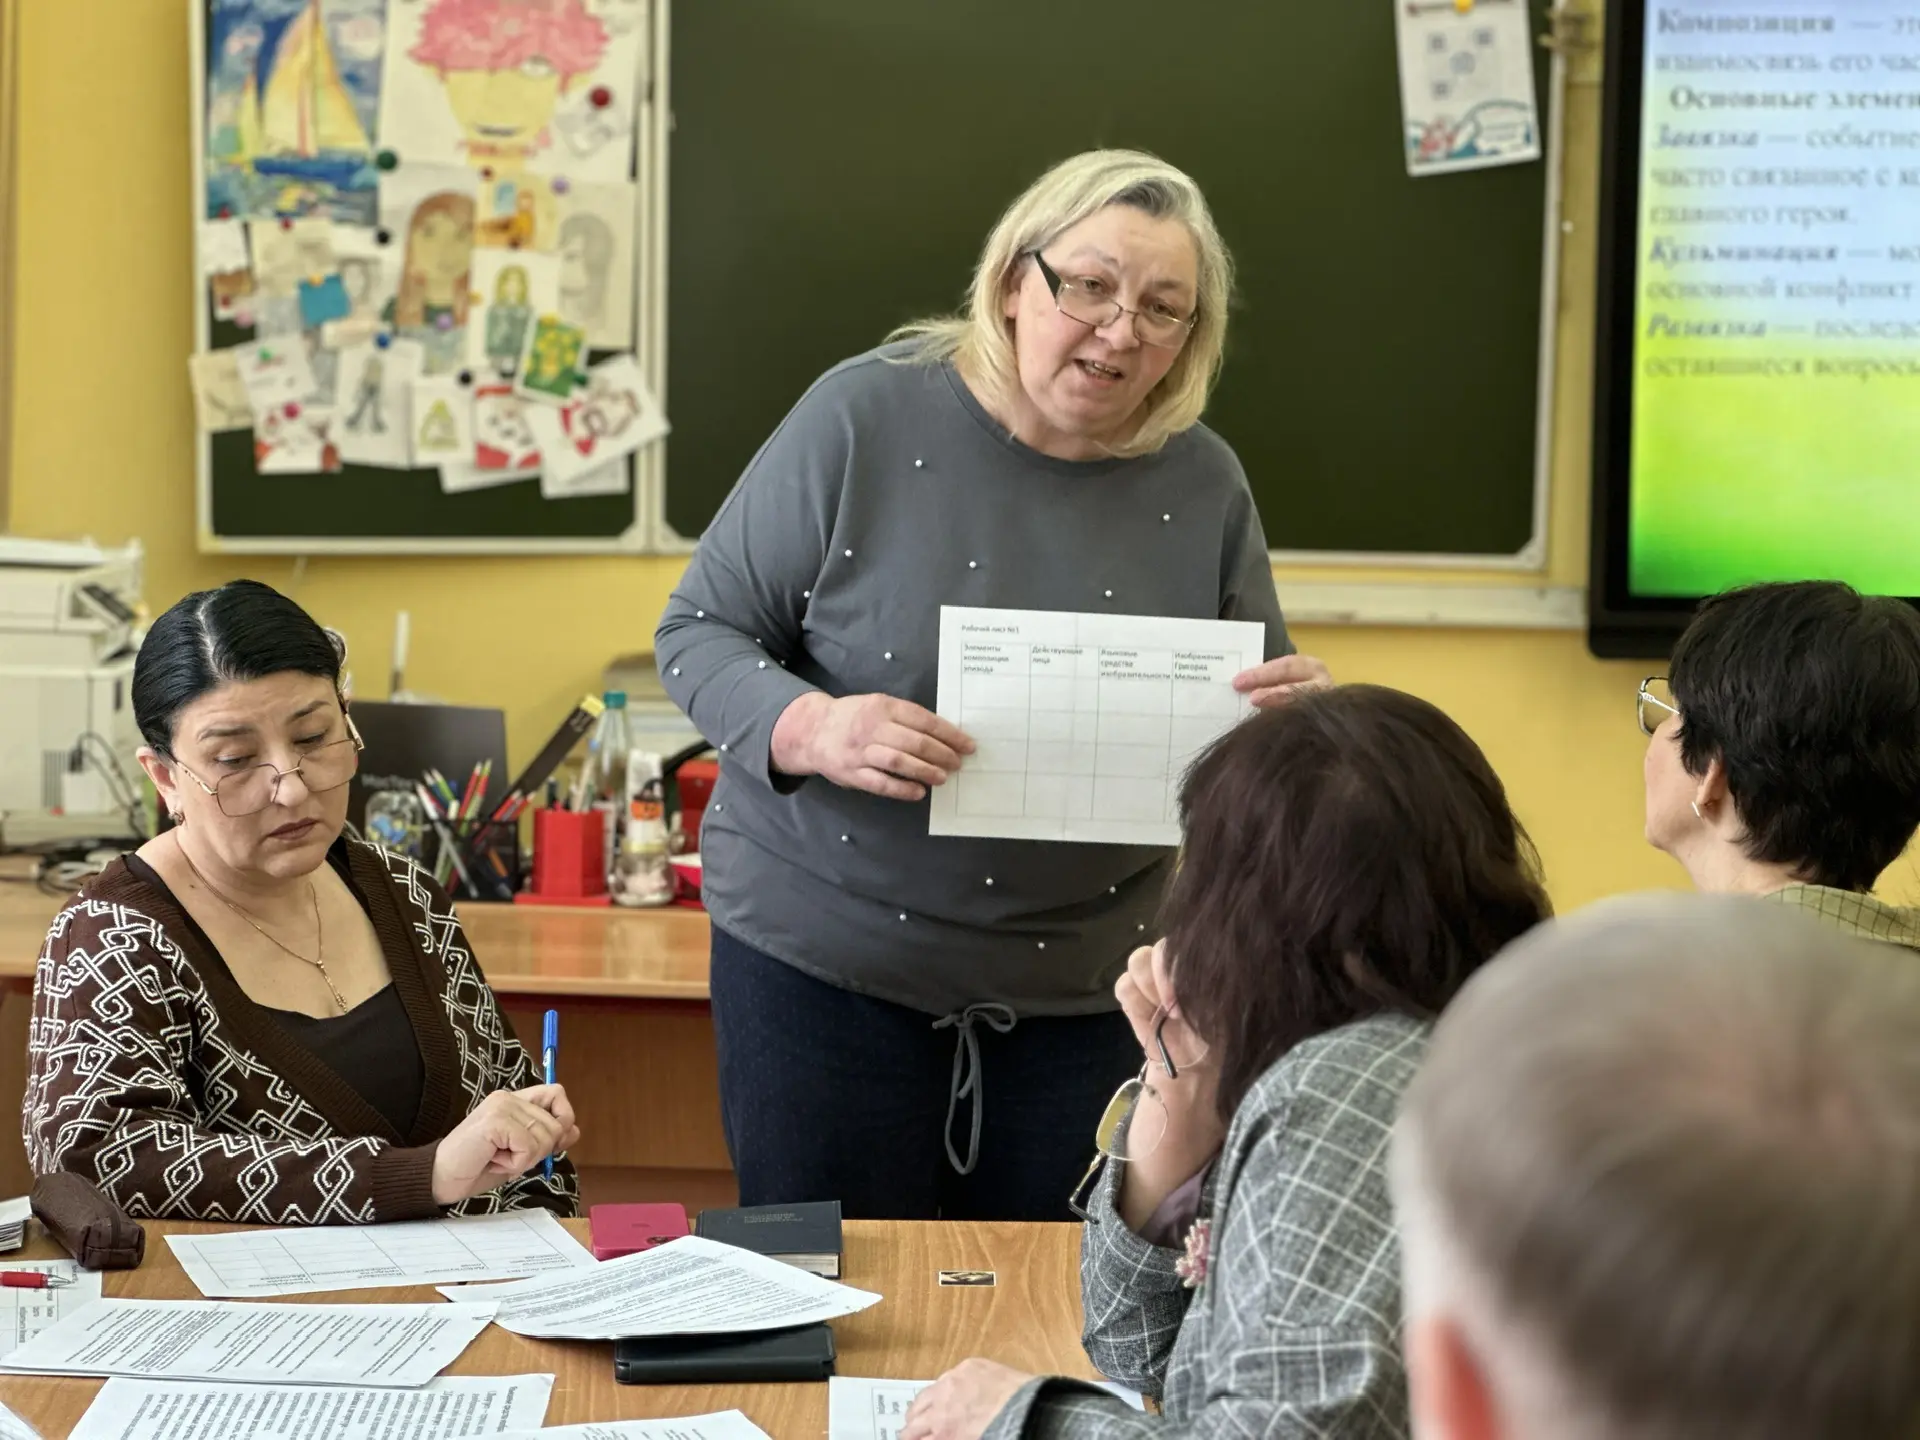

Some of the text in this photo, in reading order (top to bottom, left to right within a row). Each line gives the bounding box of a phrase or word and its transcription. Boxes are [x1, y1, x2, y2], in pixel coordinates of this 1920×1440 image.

[1656, 8, 1834, 37] Композиция
[1828, 53, 1873, 74] его
[1668, 85, 1818, 112] Основные
[1654, 122, 1760, 150] Завязка
[1650, 167, 1726, 188] часто
[1649, 206, 1771, 226] главного
[1647, 235, 1838, 270] Кульминация
[1645, 274, 1913, 309] основной конфликт
[1647, 311, 1767, 338] Развязка
